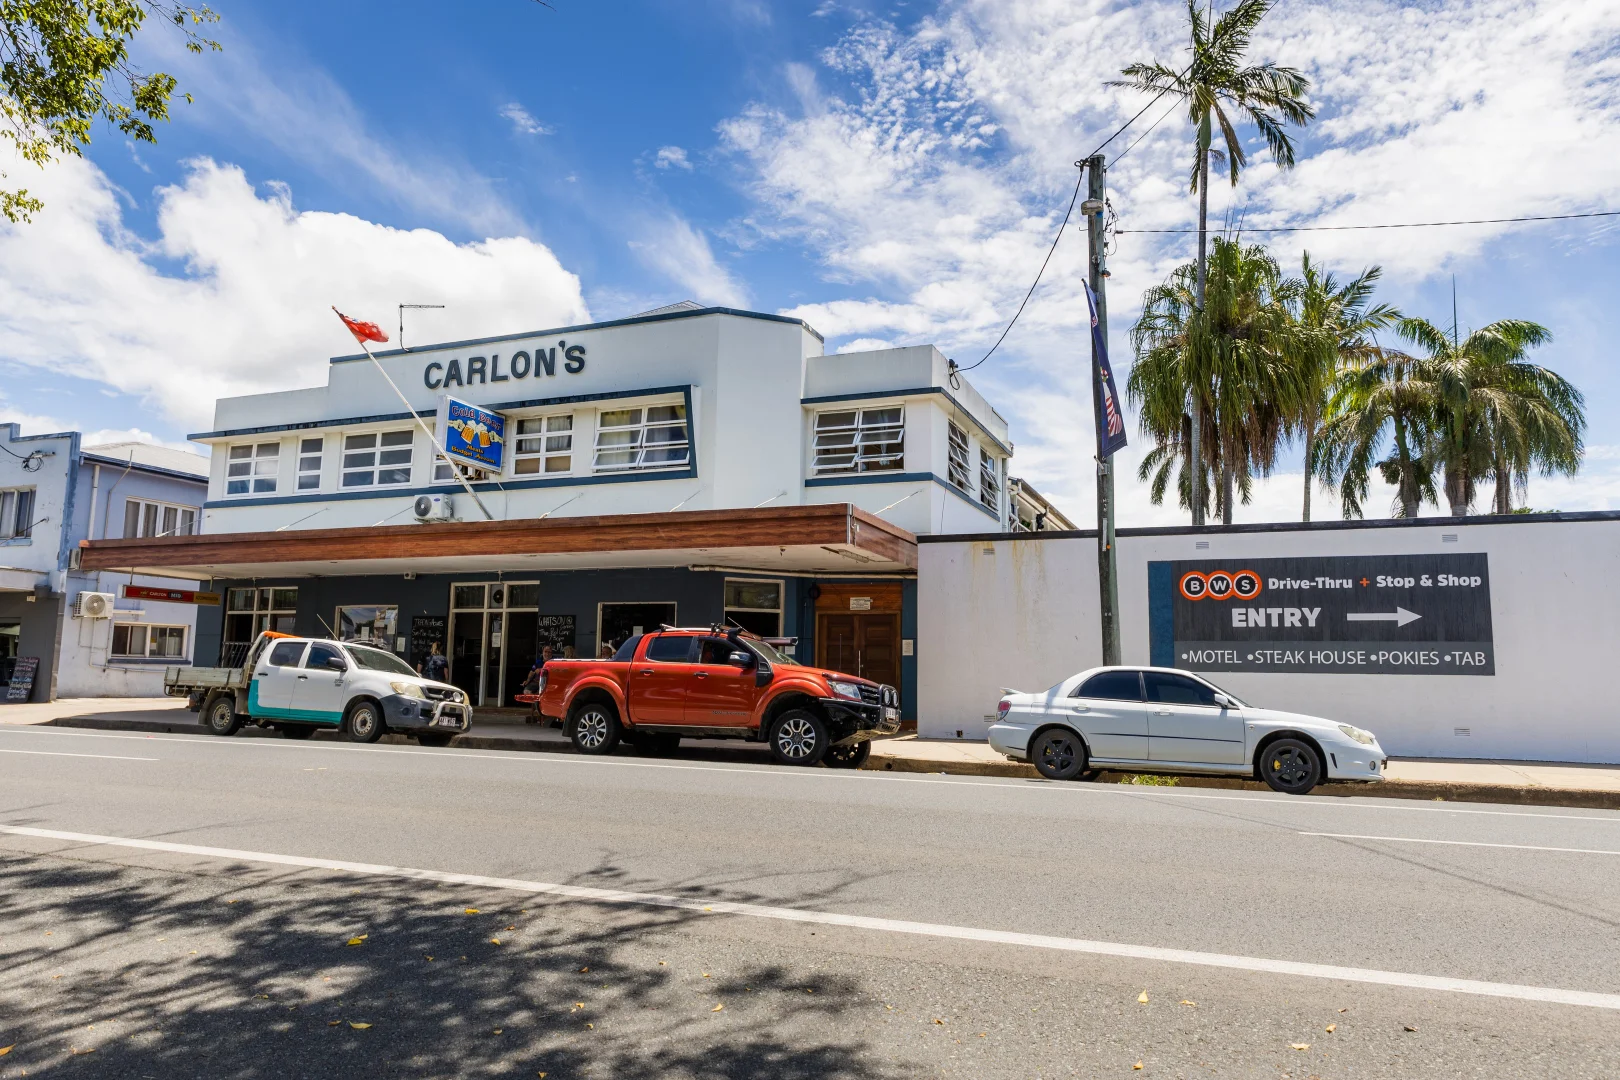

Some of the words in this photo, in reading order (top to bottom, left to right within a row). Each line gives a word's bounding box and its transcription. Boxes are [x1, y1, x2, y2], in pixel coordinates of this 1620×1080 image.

[424, 340, 587, 390] CARLON'S
[451, 405, 476, 419] Cold
[478, 411, 502, 430] Beer
[451, 445, 473, 457] Budget
[1268, 577, 1353, 590] Drive-Thru
[1376, 575, 1415, 589] Stop
[1420, 574, 1433, 587] &
[1437, 574, 1482, 588] Shop
[1231, 607, 1321, 628] ENTRY
[1309, 650, 1367, 665] HOUSE
